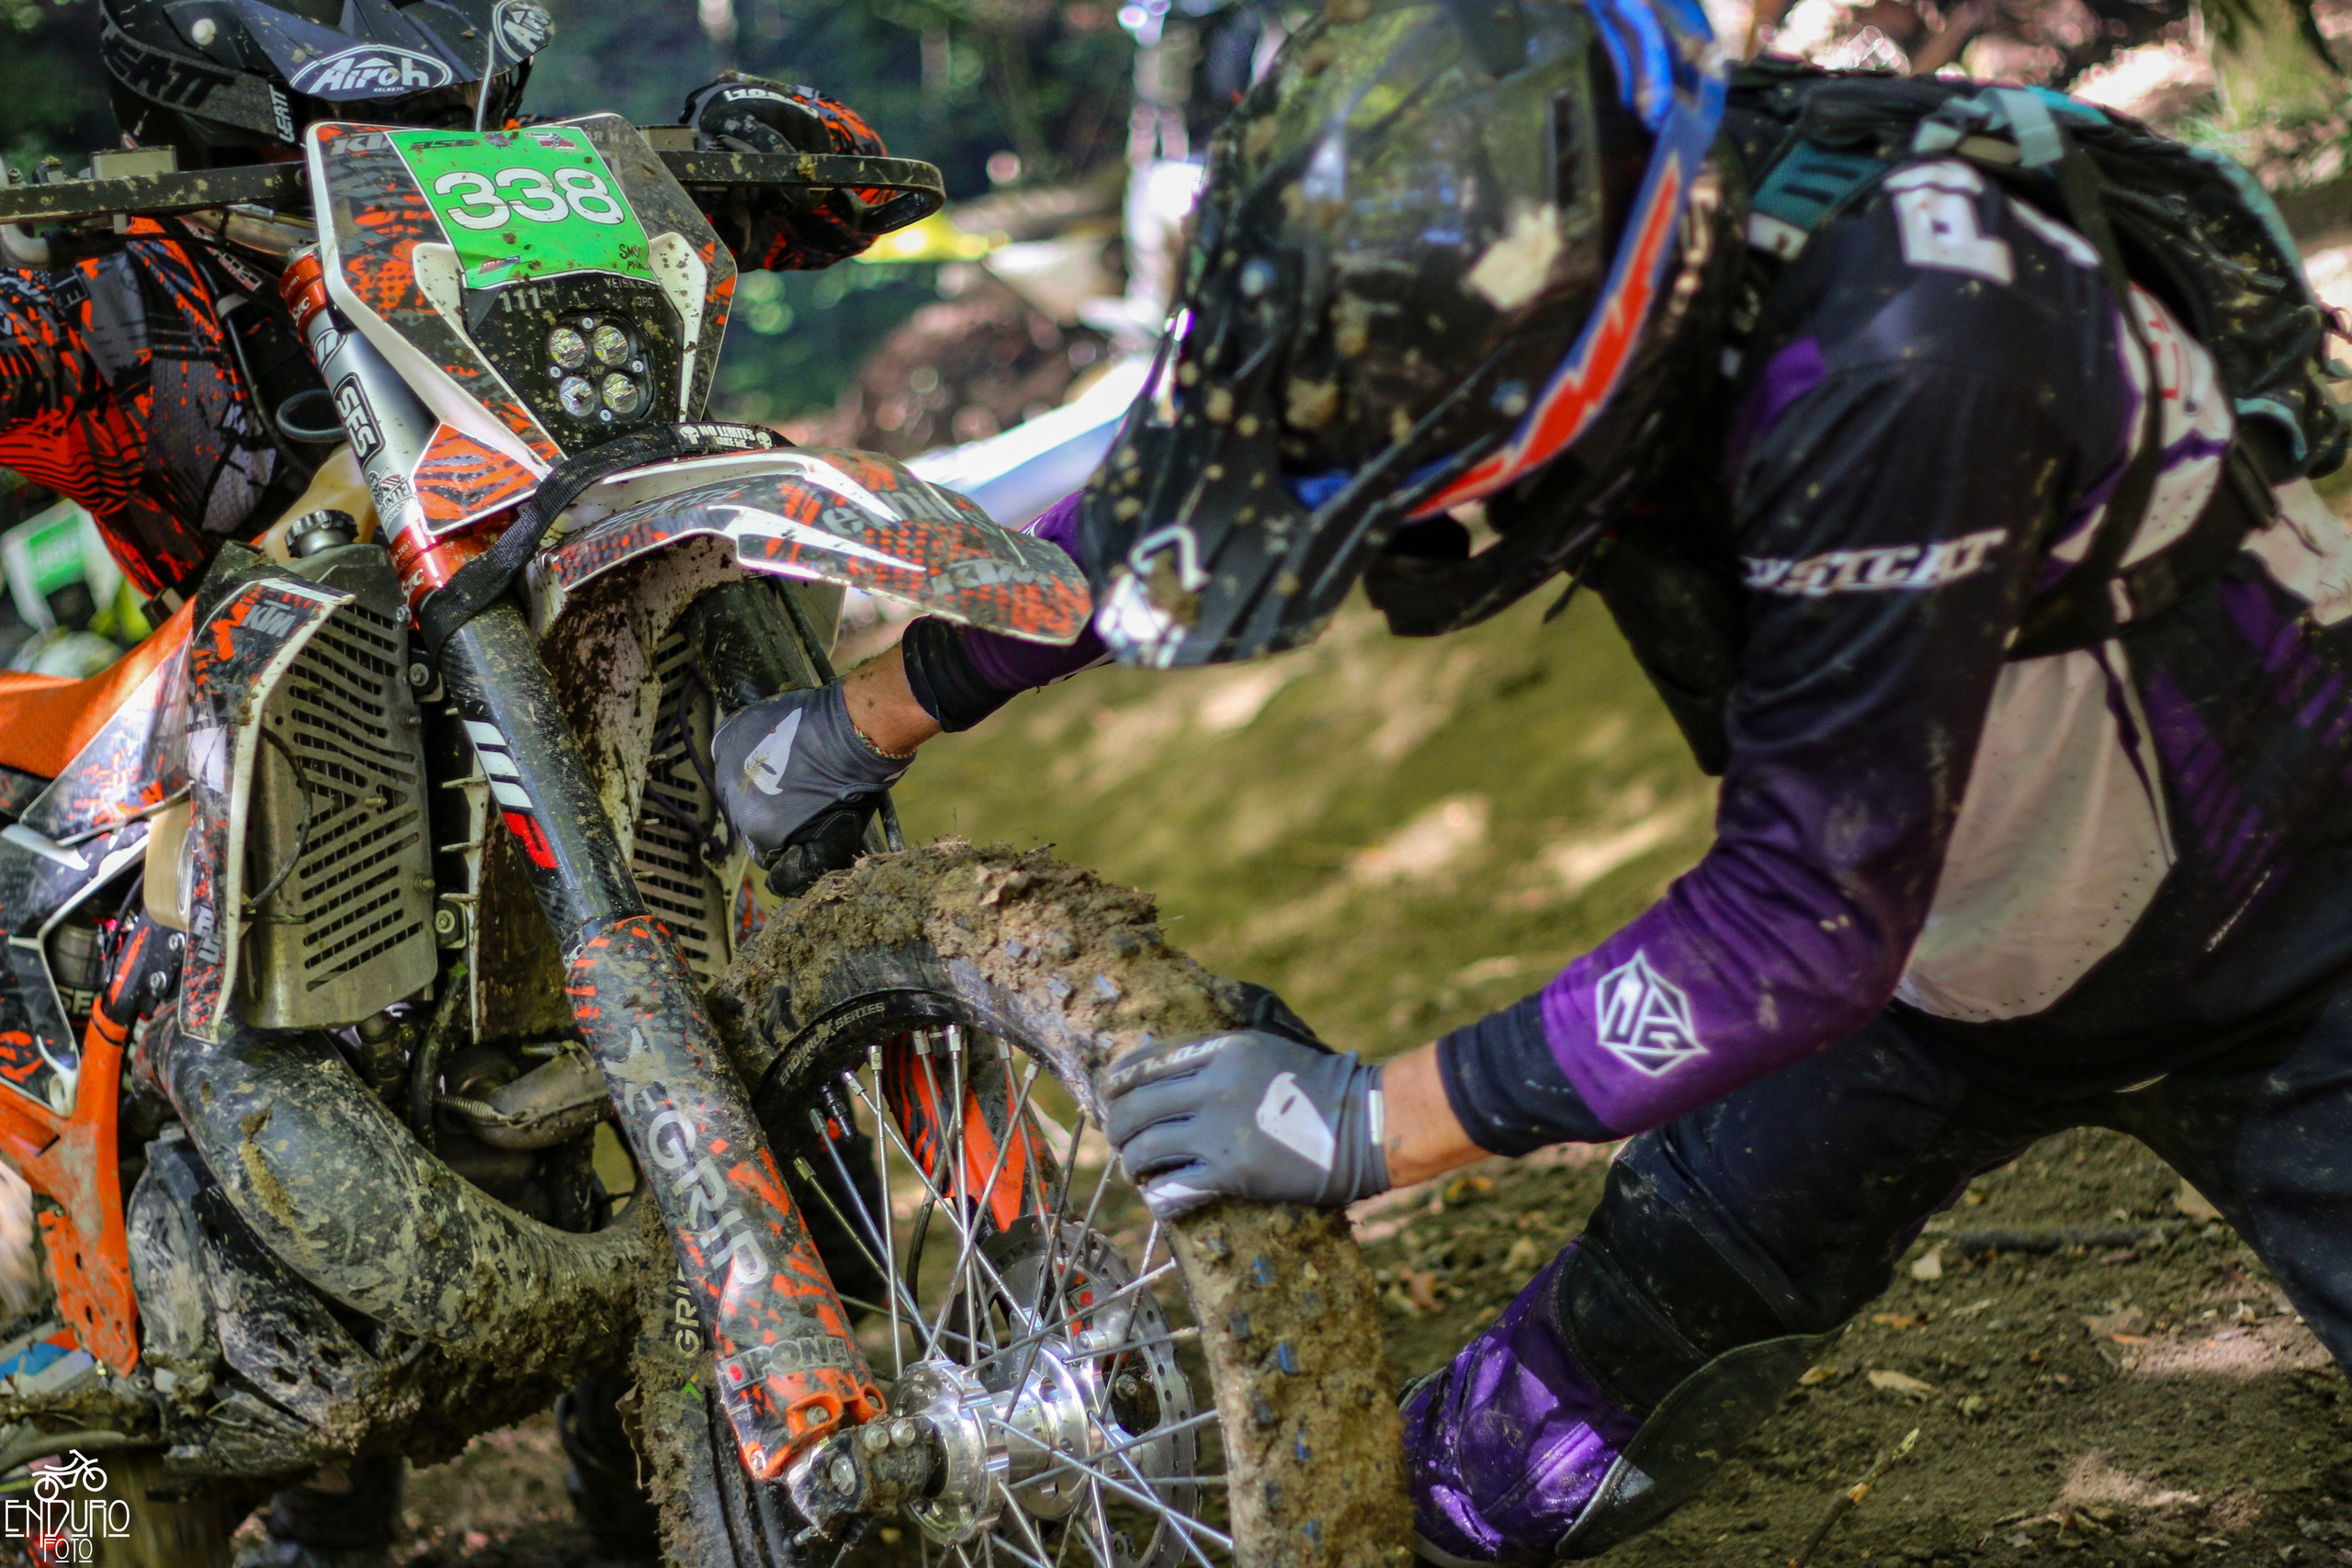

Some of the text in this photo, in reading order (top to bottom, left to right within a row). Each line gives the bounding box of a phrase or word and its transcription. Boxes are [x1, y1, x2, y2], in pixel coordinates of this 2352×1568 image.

[307, 57, 429, 93] Airoh
[268, 85, 295, 143] LEATT
[329, 133, 391, 155] KT
[435, 167, 625, 230] 338
[498, 288, 540, 312] 111
[336, 385, 378, 458] SFS
[698, 425, 756, 441] NO LIMITS
[242, 599, 296, 638] KTM
[834, 1002, 886, 1031] SERIES
[602, 1026, 769, 1284] X-GRIP
